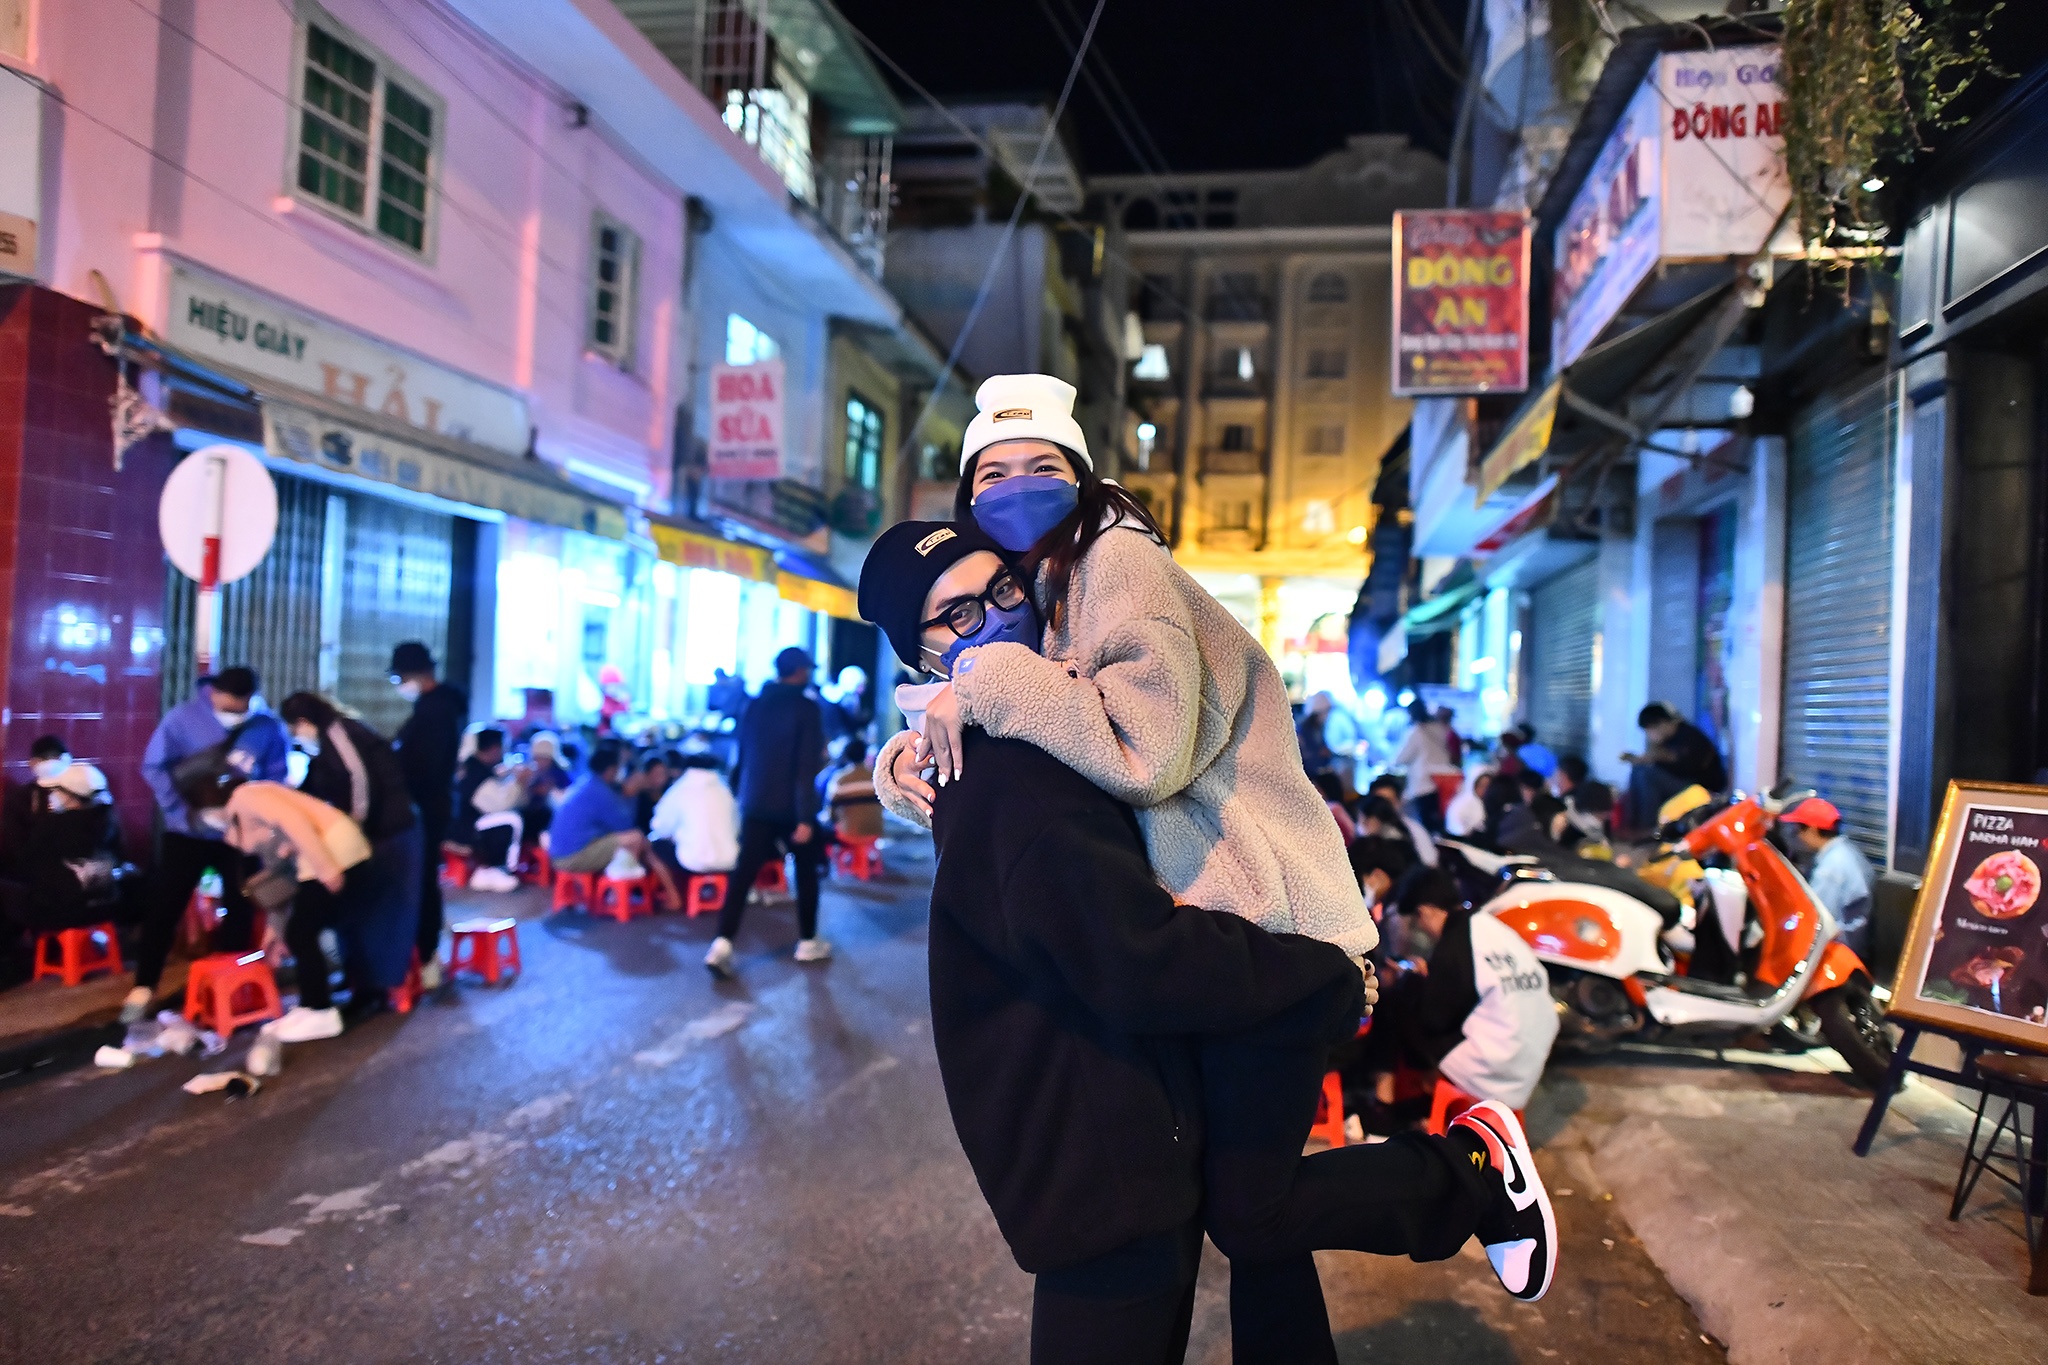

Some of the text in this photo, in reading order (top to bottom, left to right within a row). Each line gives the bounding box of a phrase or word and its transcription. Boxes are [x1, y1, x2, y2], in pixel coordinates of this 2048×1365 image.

[1672, 101, 1748, 141] ĐÔNG
[188, 296, 248, 343] HIỆU
[1433, 296, 1488, 327] AN
[717, 372, 775, 403] HOA
[1972, 813, 2015, 831] PIZZA
